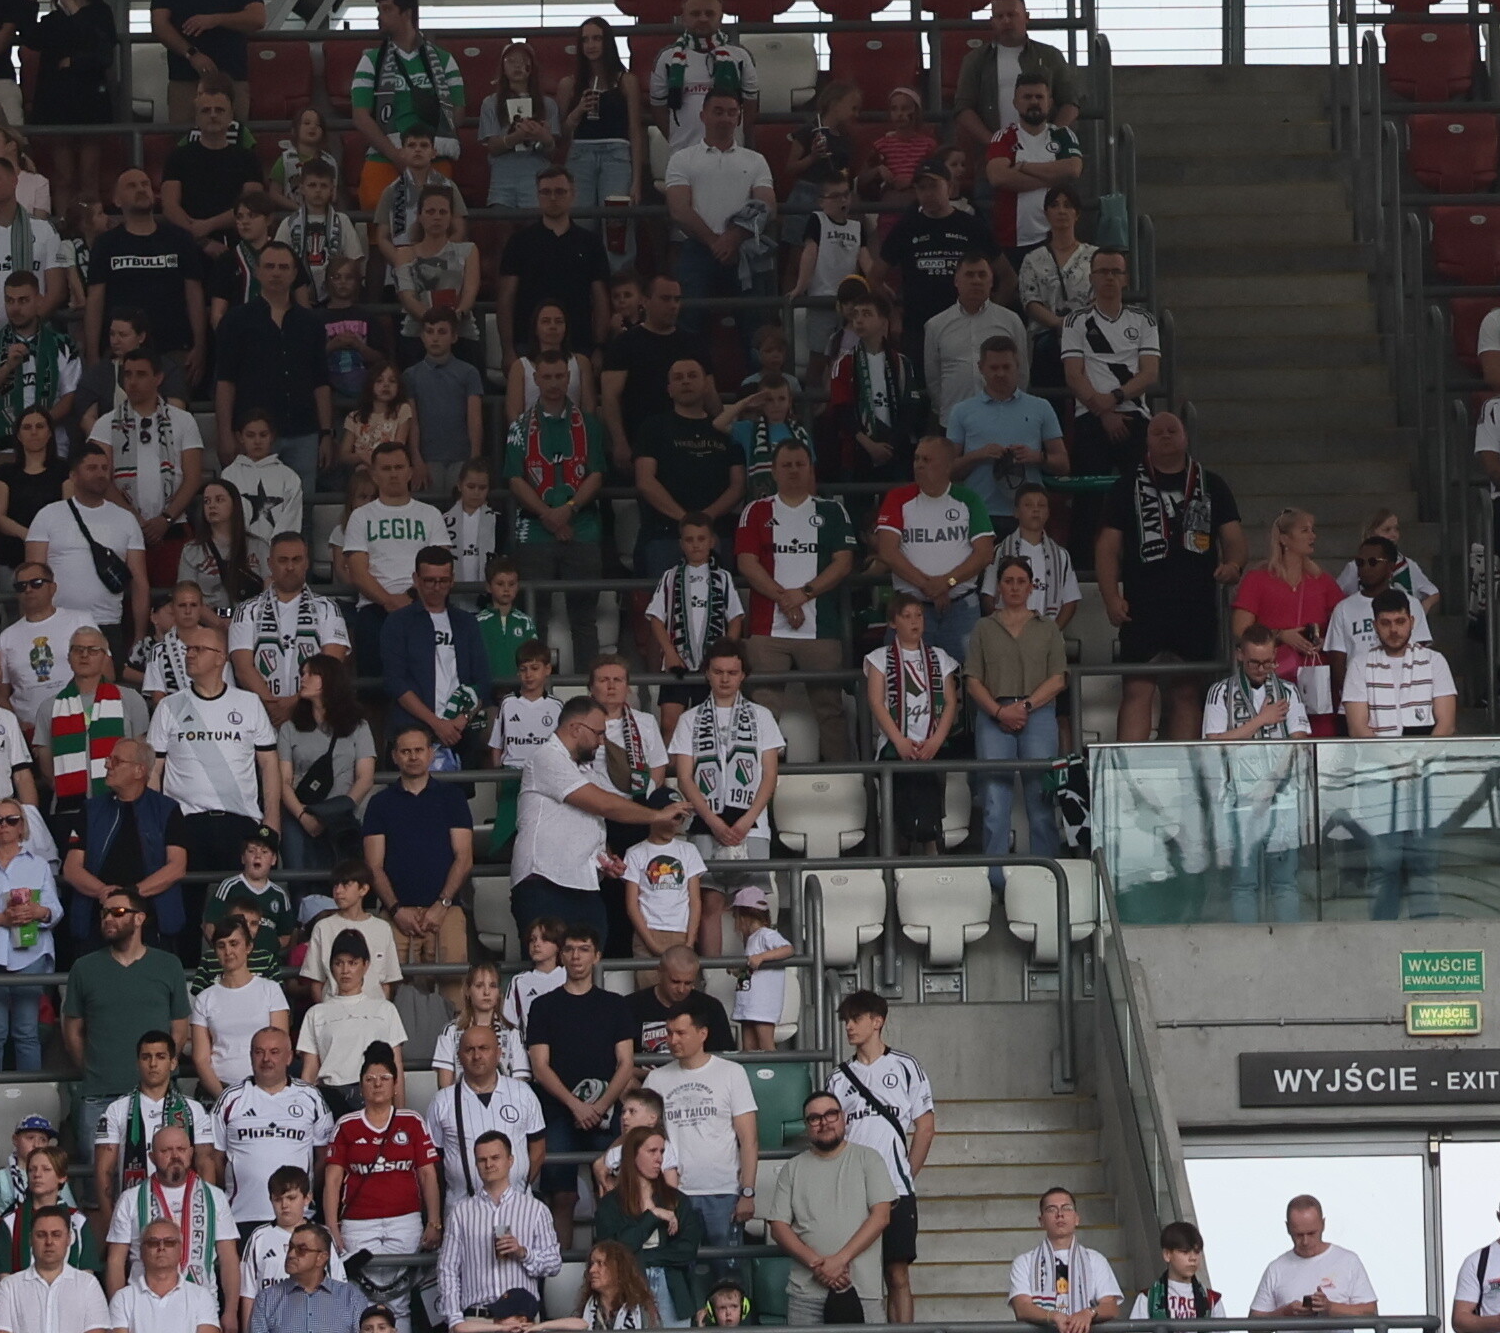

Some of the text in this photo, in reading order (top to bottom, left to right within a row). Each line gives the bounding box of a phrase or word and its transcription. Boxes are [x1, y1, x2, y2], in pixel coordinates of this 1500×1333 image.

[111, 257, 165, 269] PITBULL
[366, 518, 426, 542] LEGIA
[902, 526, 968, 543] BIELANY
[774, 543, 818, 554] lus50
[177, 731, 242, 742] FORTUNA
[506, 735, 548, 745] Plus50
[730, 788, 753, 804] 1916
[1408, 956, 1476, 972] WYJŚCIE
[1404, 975, 1480, 985] EWAKUACYJNE
[1419, 1006, 1470, 1018] WYJŚCIE
[1415, 1018, 1474, 1027] EWAKUACYJNE
[1273, 1062, 1418, 1093] WYJŚCIE
[1447, 1070, 1499, 1091] EXIT
[685, 1107, 718, 1118] TAILOR
[237, 1127, 305, 1141] Plus500
[350, 1160, 413, 1175] Plus500
[191, 1188, 204, 1260] LEGIA
